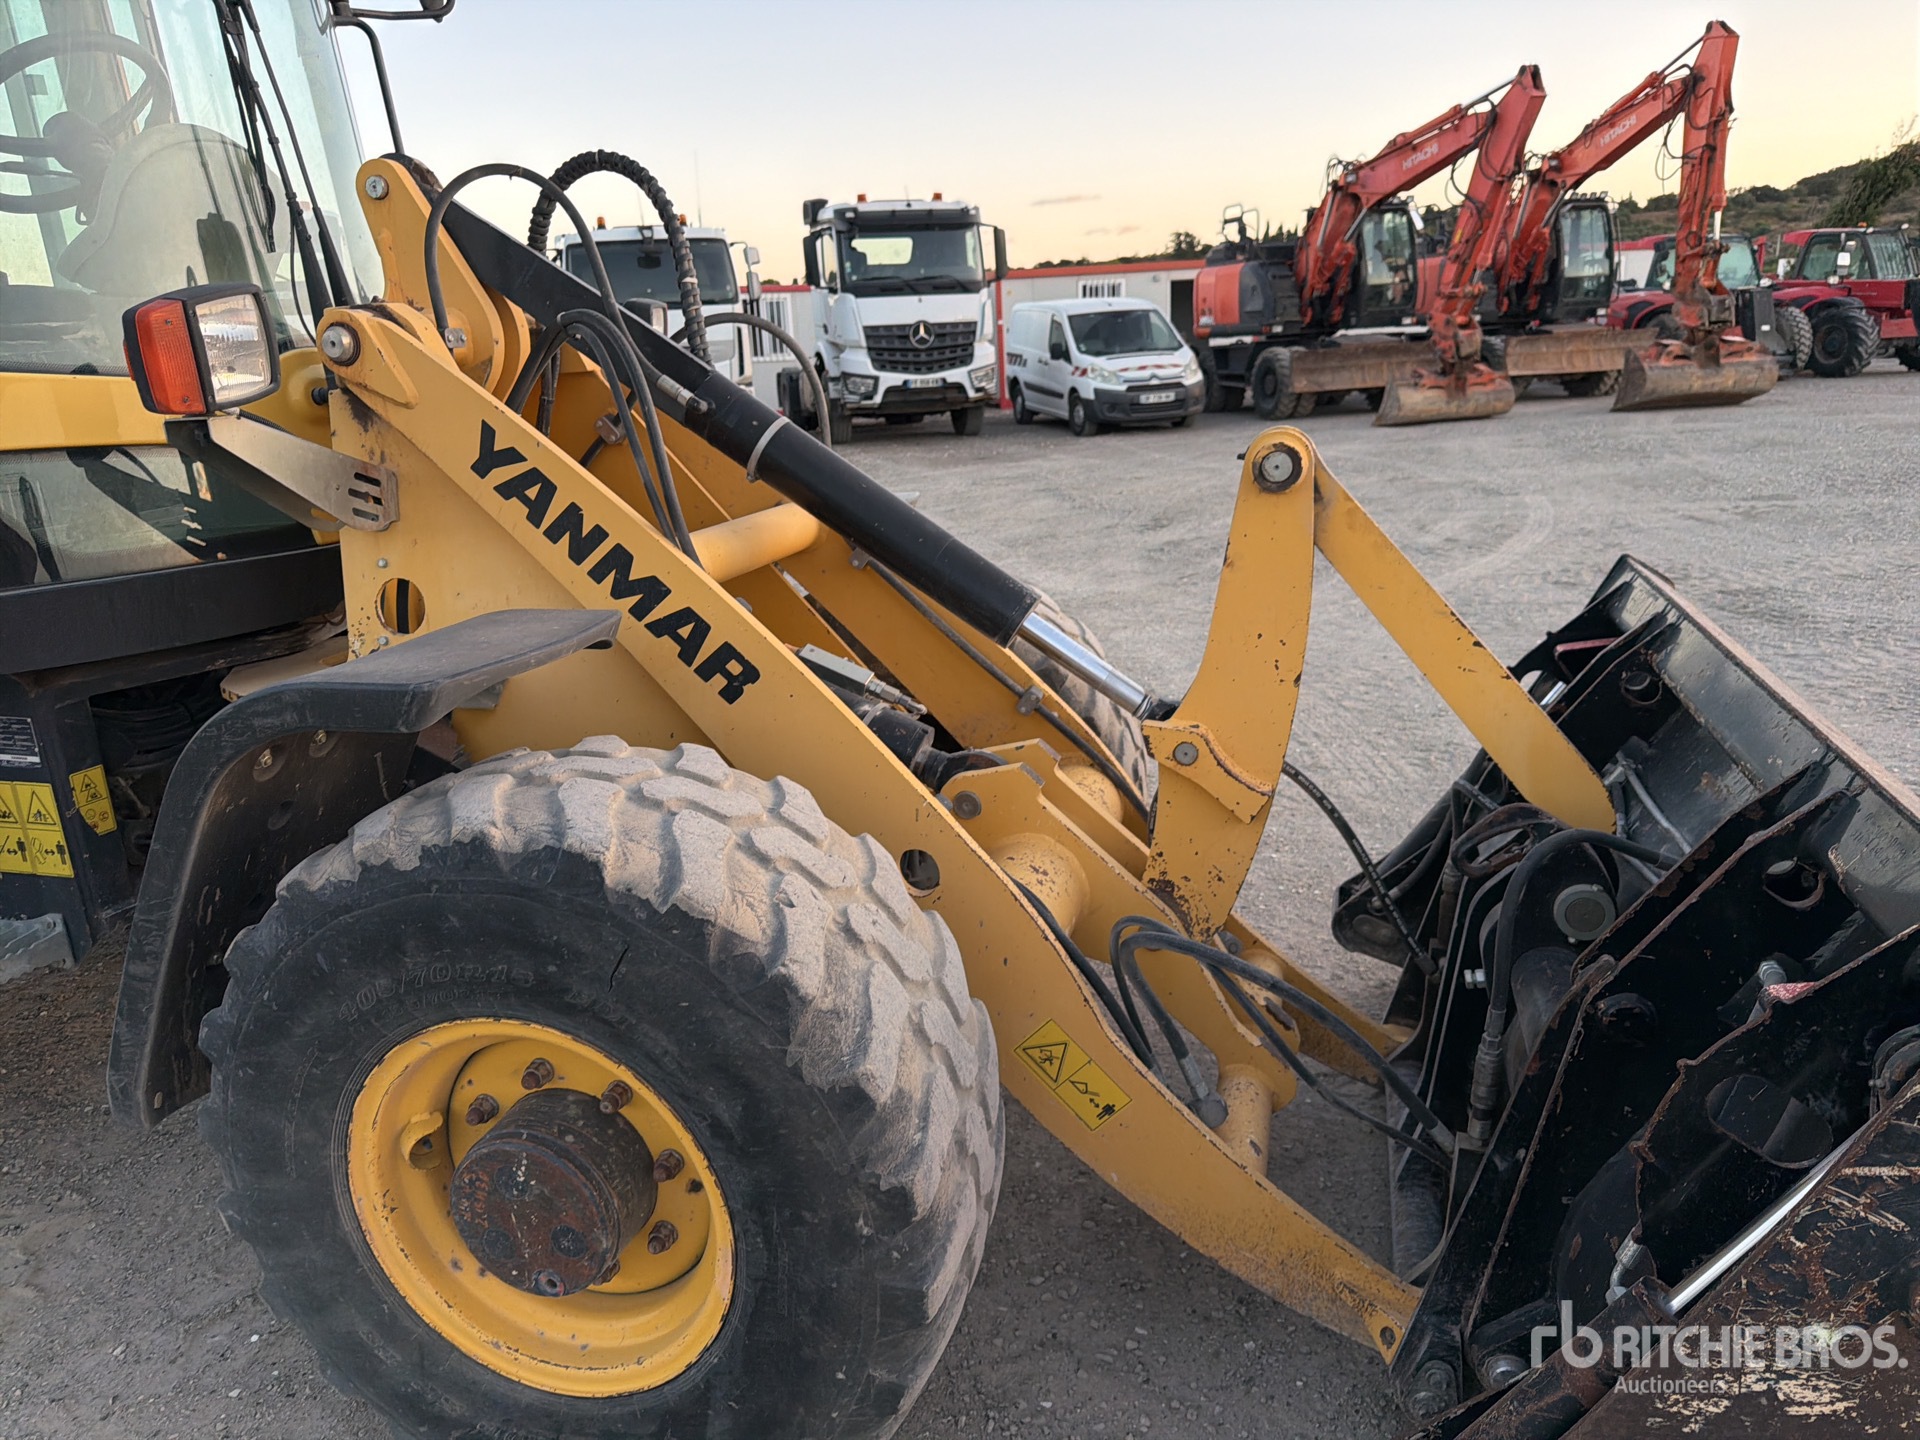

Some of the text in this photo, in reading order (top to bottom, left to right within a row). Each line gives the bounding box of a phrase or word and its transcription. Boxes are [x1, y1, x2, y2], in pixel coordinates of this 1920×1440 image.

[1600, 114, 1637, 147] HITACHI
[1402, 143, 1439, 171] HITACHI
[470, 419, 761, 704] YANMAR
